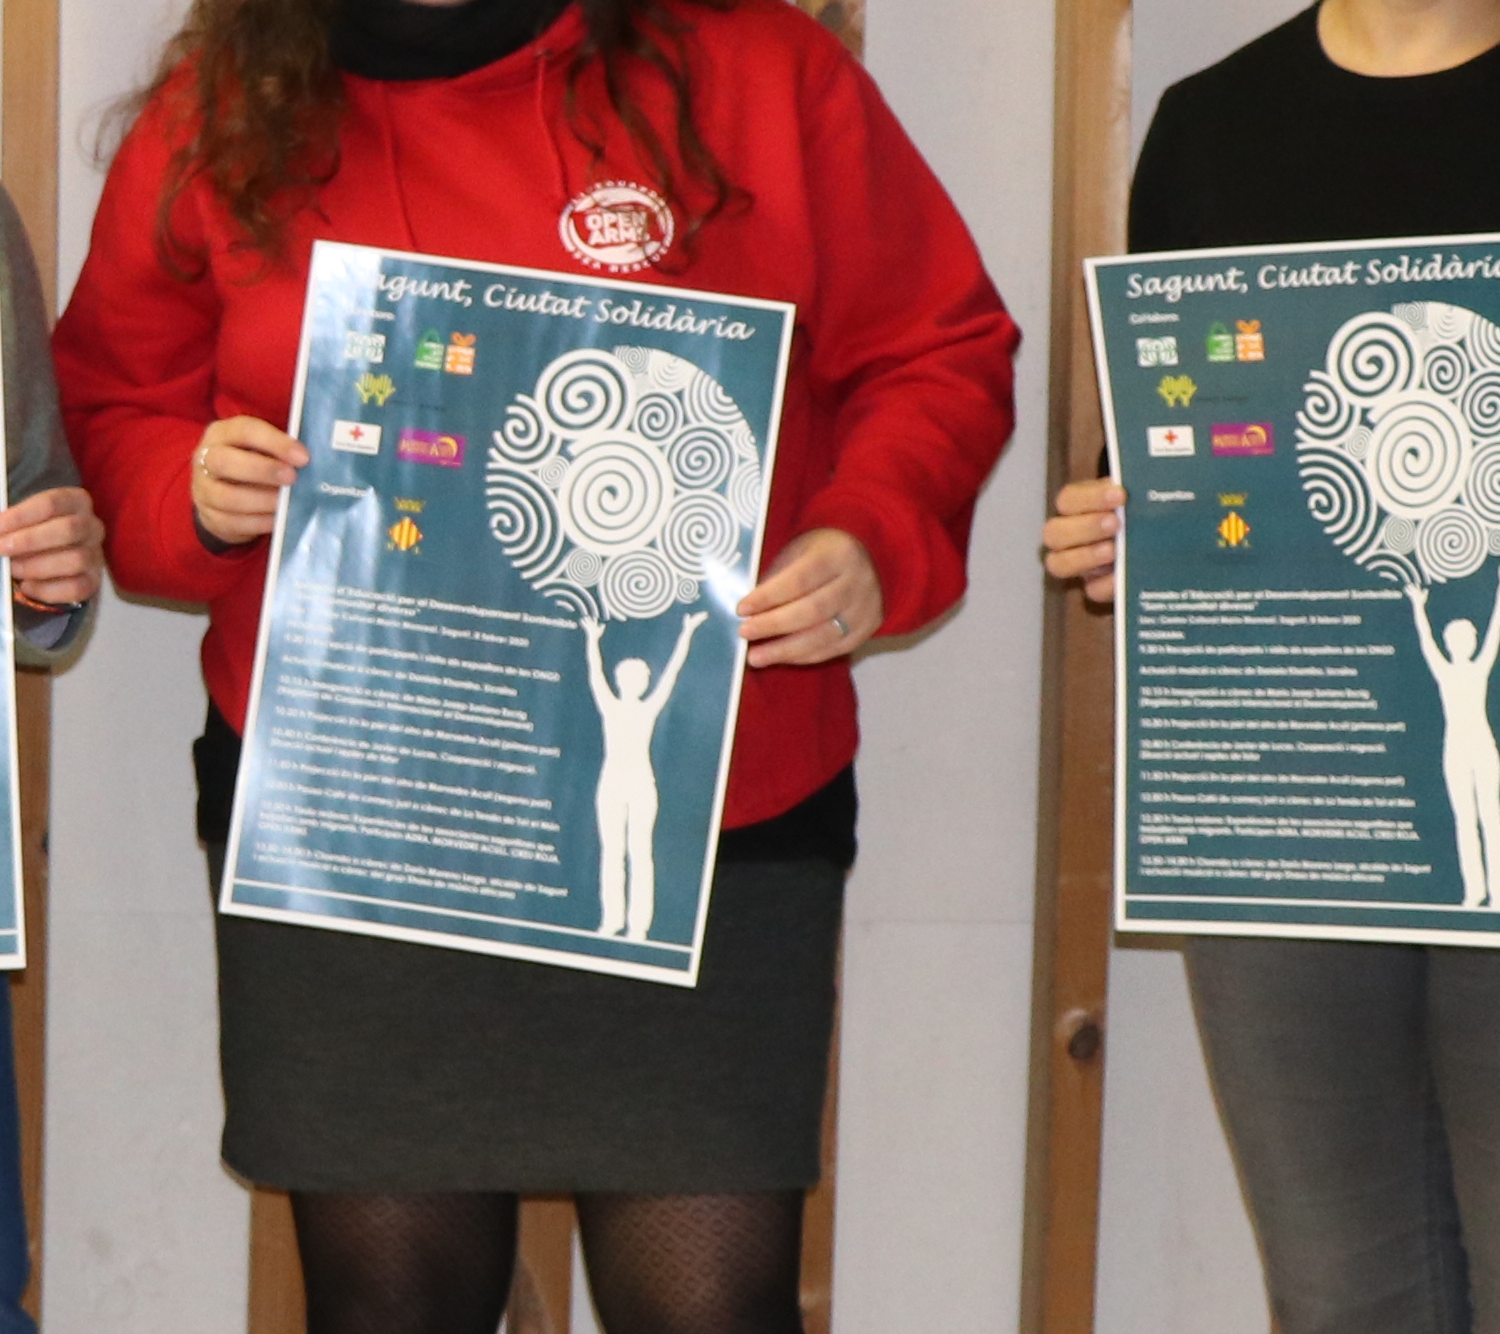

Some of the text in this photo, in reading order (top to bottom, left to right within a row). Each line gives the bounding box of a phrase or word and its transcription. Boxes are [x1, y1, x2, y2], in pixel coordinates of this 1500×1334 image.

[585, 211, 648, 230] OPEN
[1126, 267, 1249, 303] Sagunt,
[1257, 261, 1362, 290] Ciutat
[484, 284, 591, 318] Ciutat
[594, 299, 757, 342] Solidària
